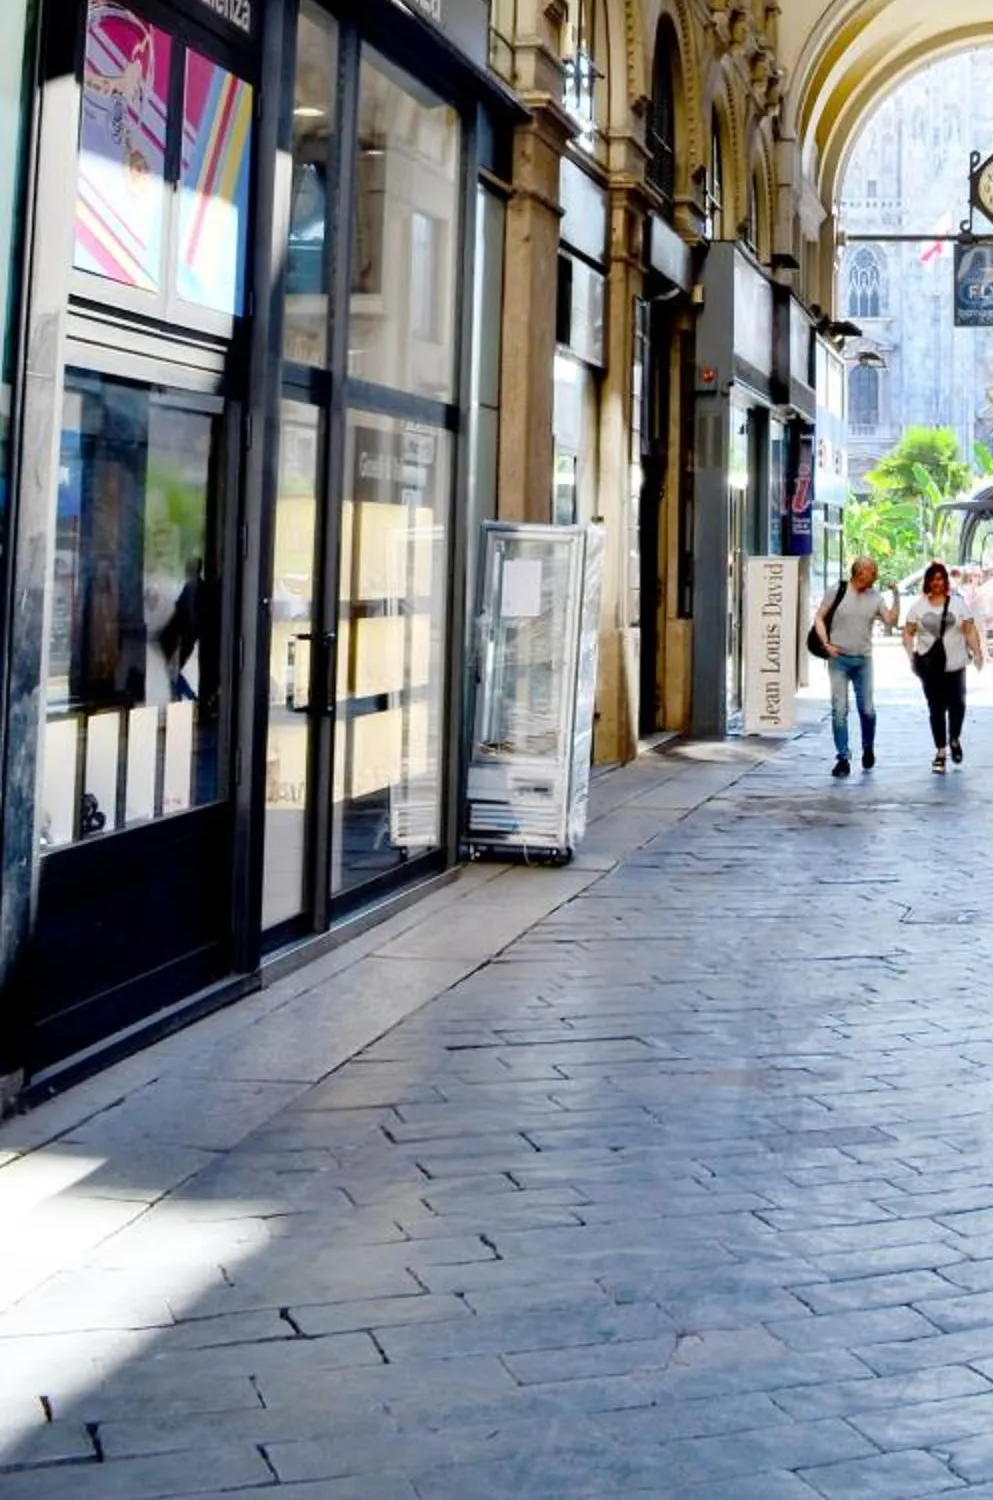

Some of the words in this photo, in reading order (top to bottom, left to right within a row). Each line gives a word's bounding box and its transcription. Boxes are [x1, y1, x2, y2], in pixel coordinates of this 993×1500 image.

[762, 563, 783, 617] David
[760, 624, 781, 674] Louis
[760, 681, 781, 724] Jean
